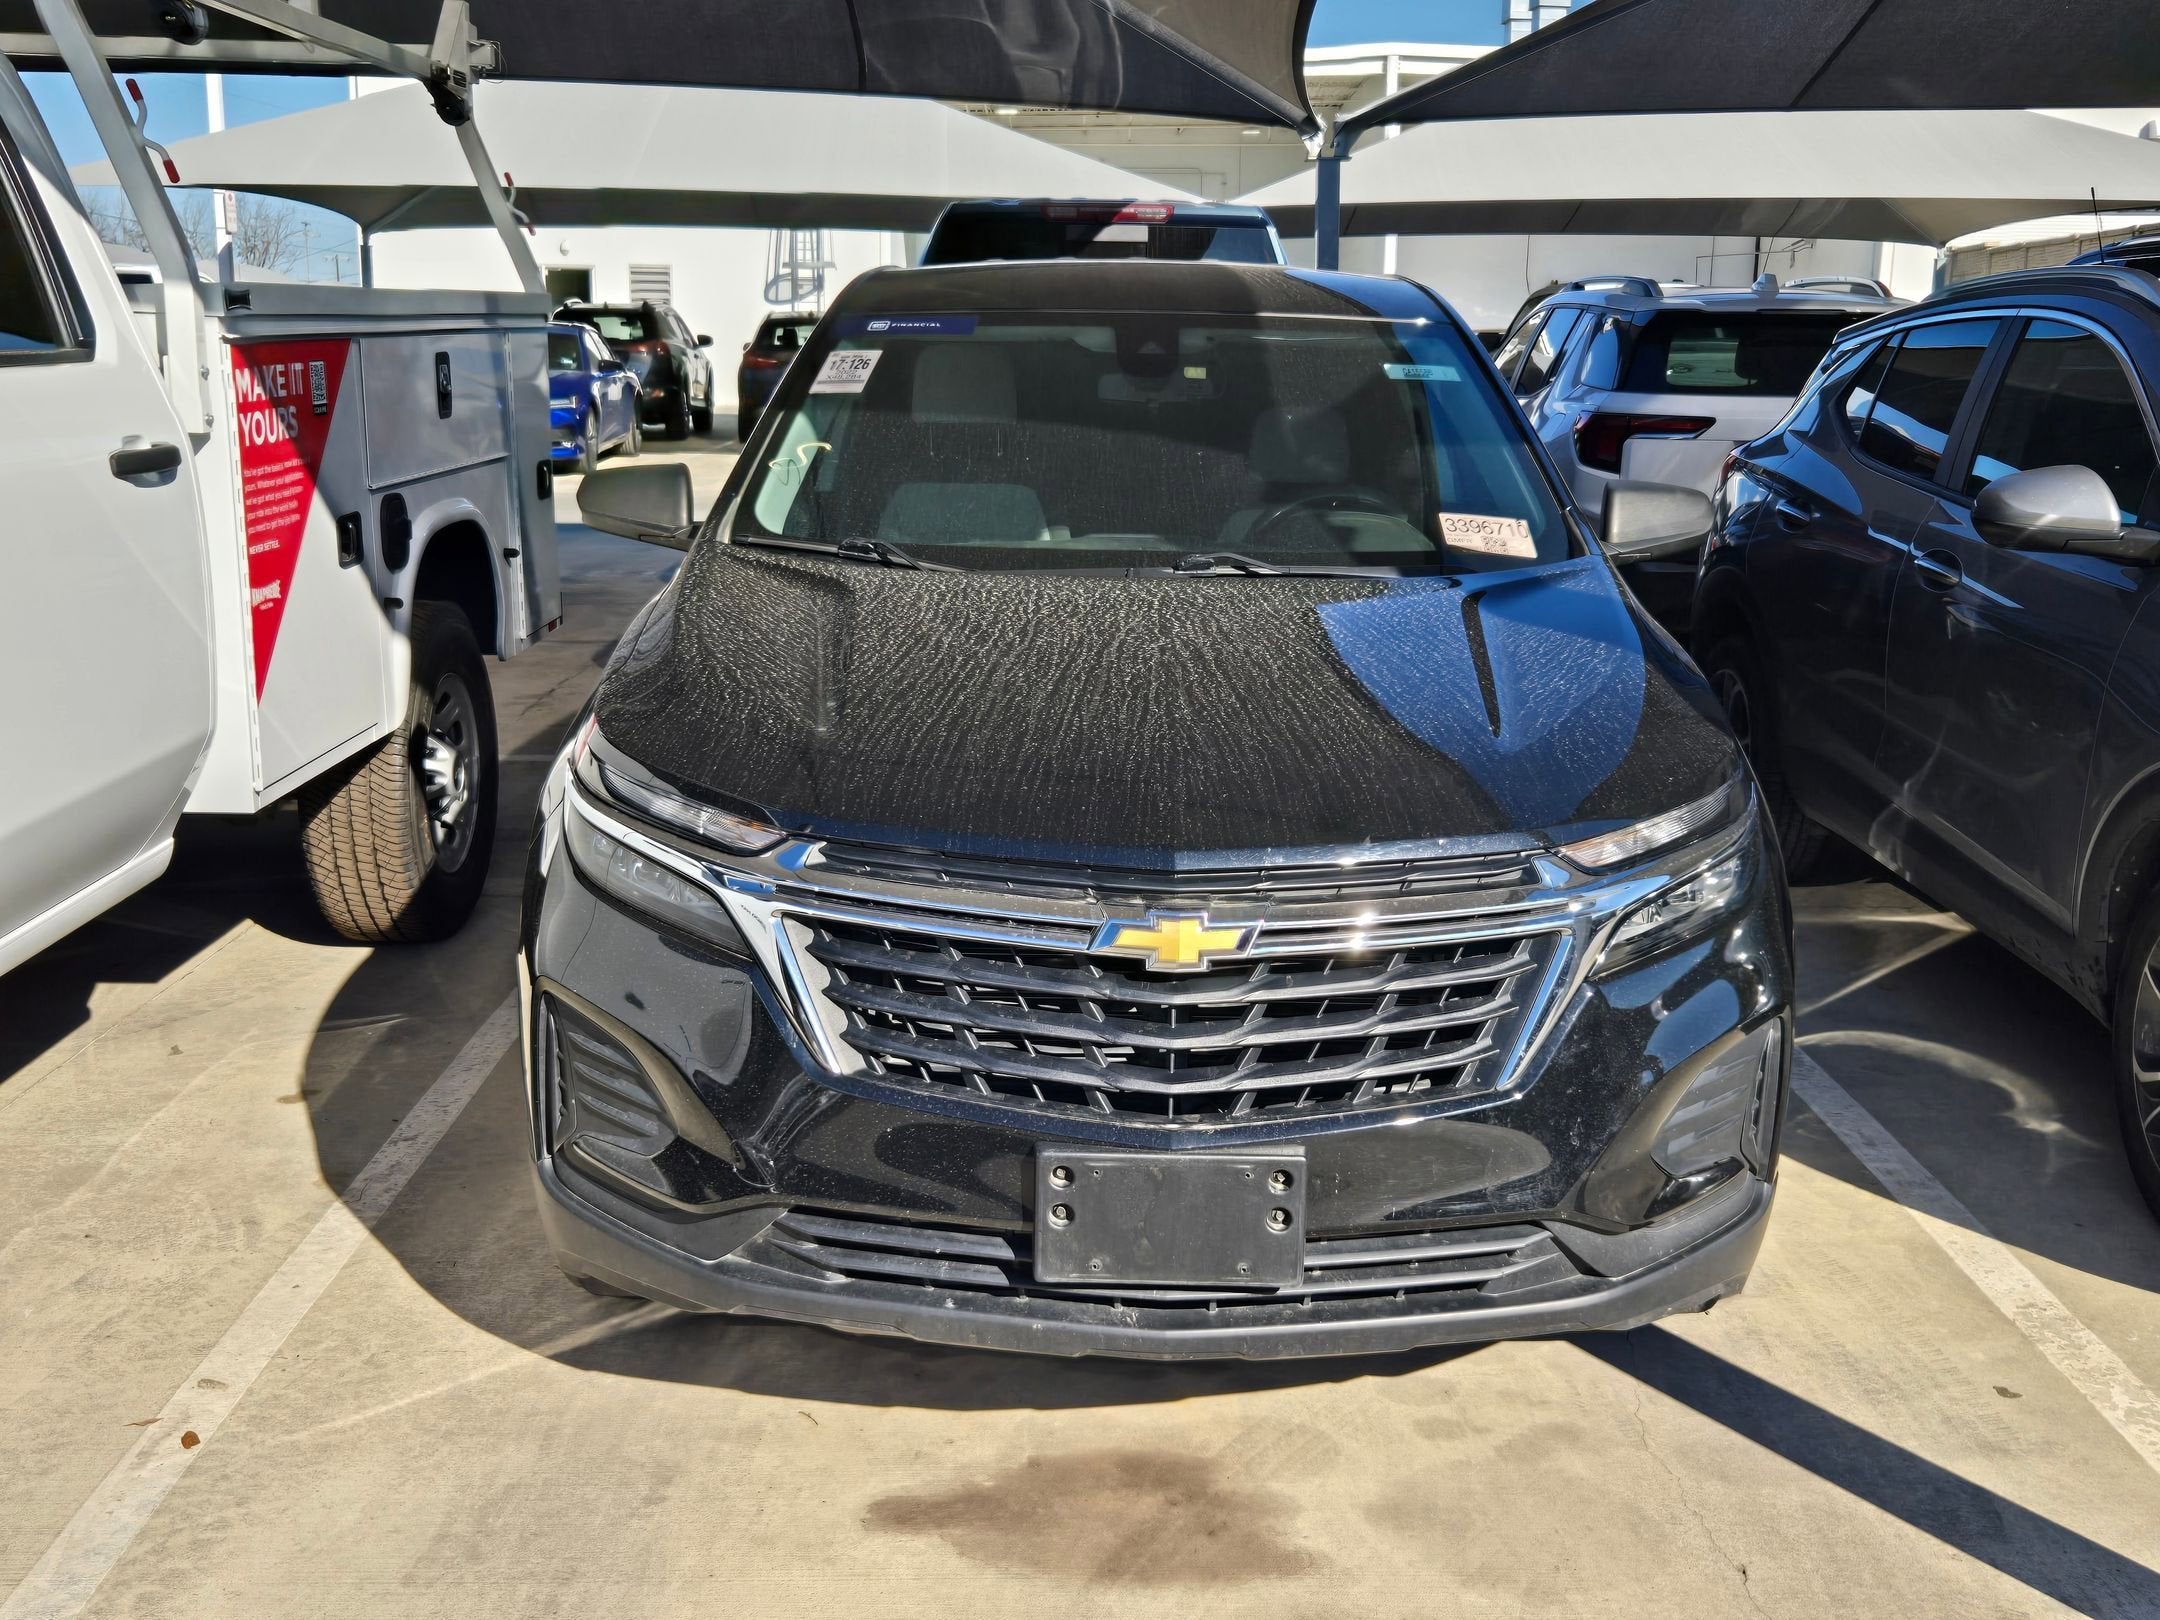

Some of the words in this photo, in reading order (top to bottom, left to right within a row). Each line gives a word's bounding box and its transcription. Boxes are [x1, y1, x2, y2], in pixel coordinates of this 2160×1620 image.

[235, 364, 287, 403] MAKE
[288, 362, 304, 395] IT
[240, 405, 299, 447] YOURS
